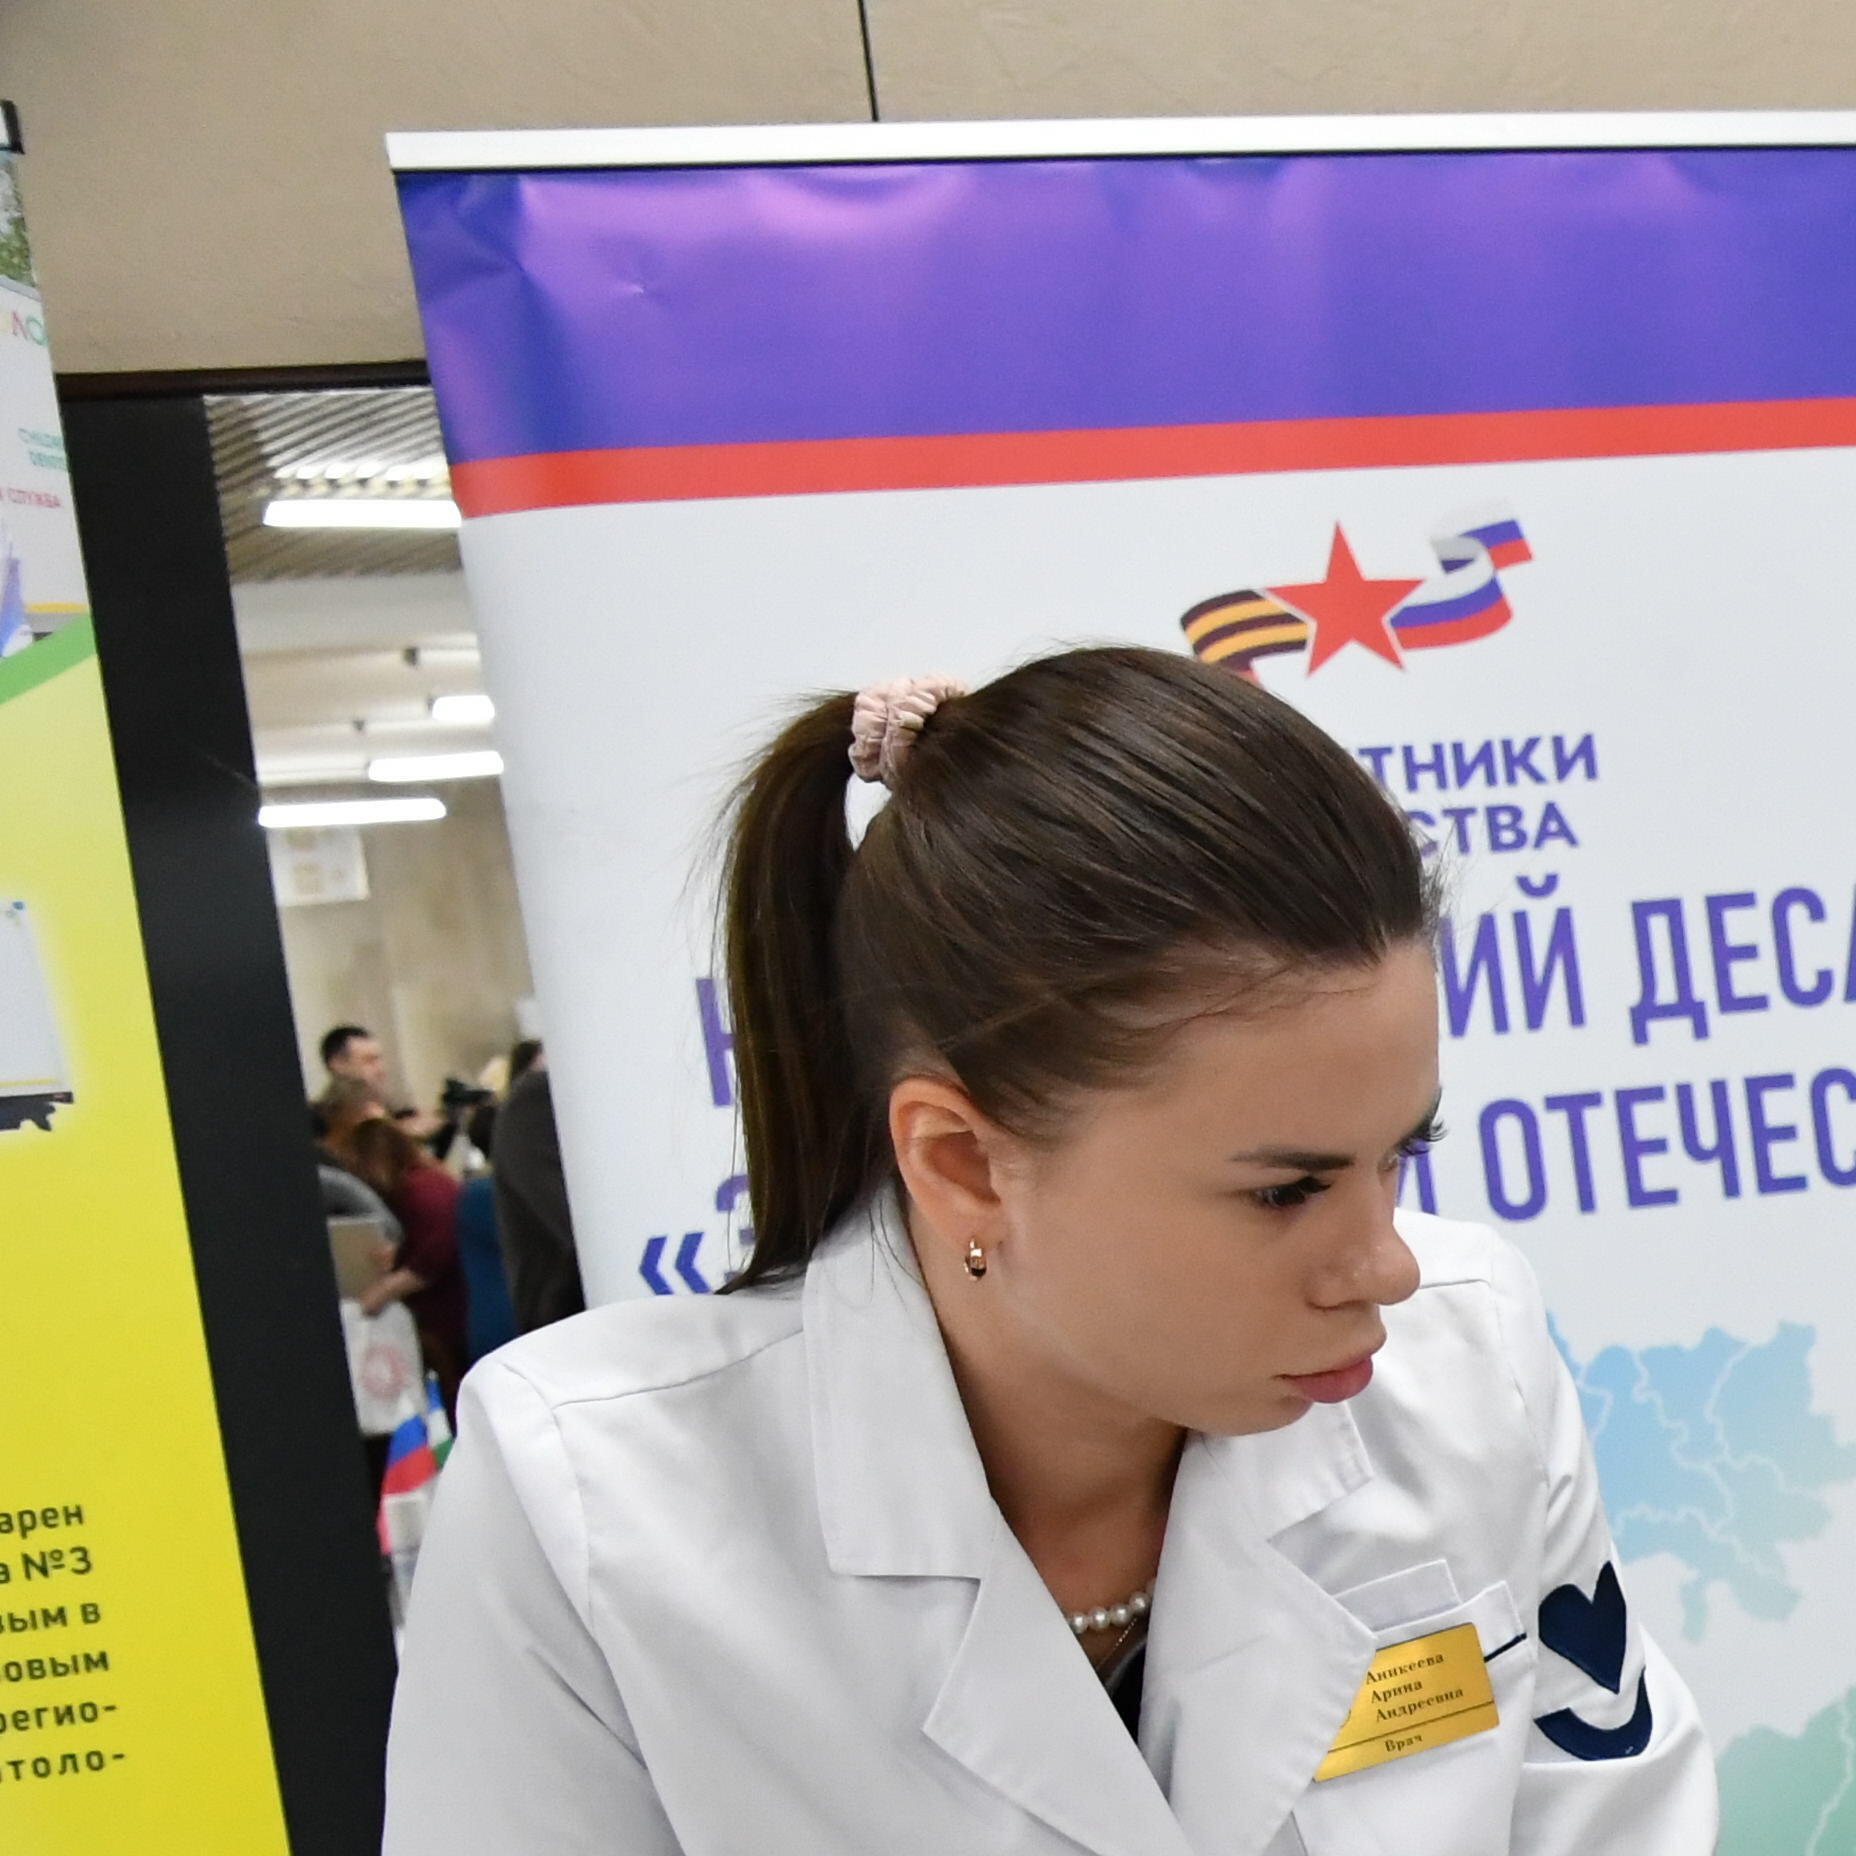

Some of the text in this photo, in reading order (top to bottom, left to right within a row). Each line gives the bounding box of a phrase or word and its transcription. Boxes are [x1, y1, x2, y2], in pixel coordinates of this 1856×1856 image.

[1358, 731, 1601, 796] ТНИКИ
[0, 1503, 84, 1540] арен
[21, 1545, 93, 1581] №3
[81, 1601, 101, 1625] в
[3, 1649, 109, 1683] овым
[1366, 1653, 1445, 1684] Аникеева
[1369, 1678, 1423, 1705] Арина
[1375, 1685, 1464, 1723] Андреевна
[1384, 1732, 1423, 1753] Врач
[6, 1749, 126, 1783] толо-
